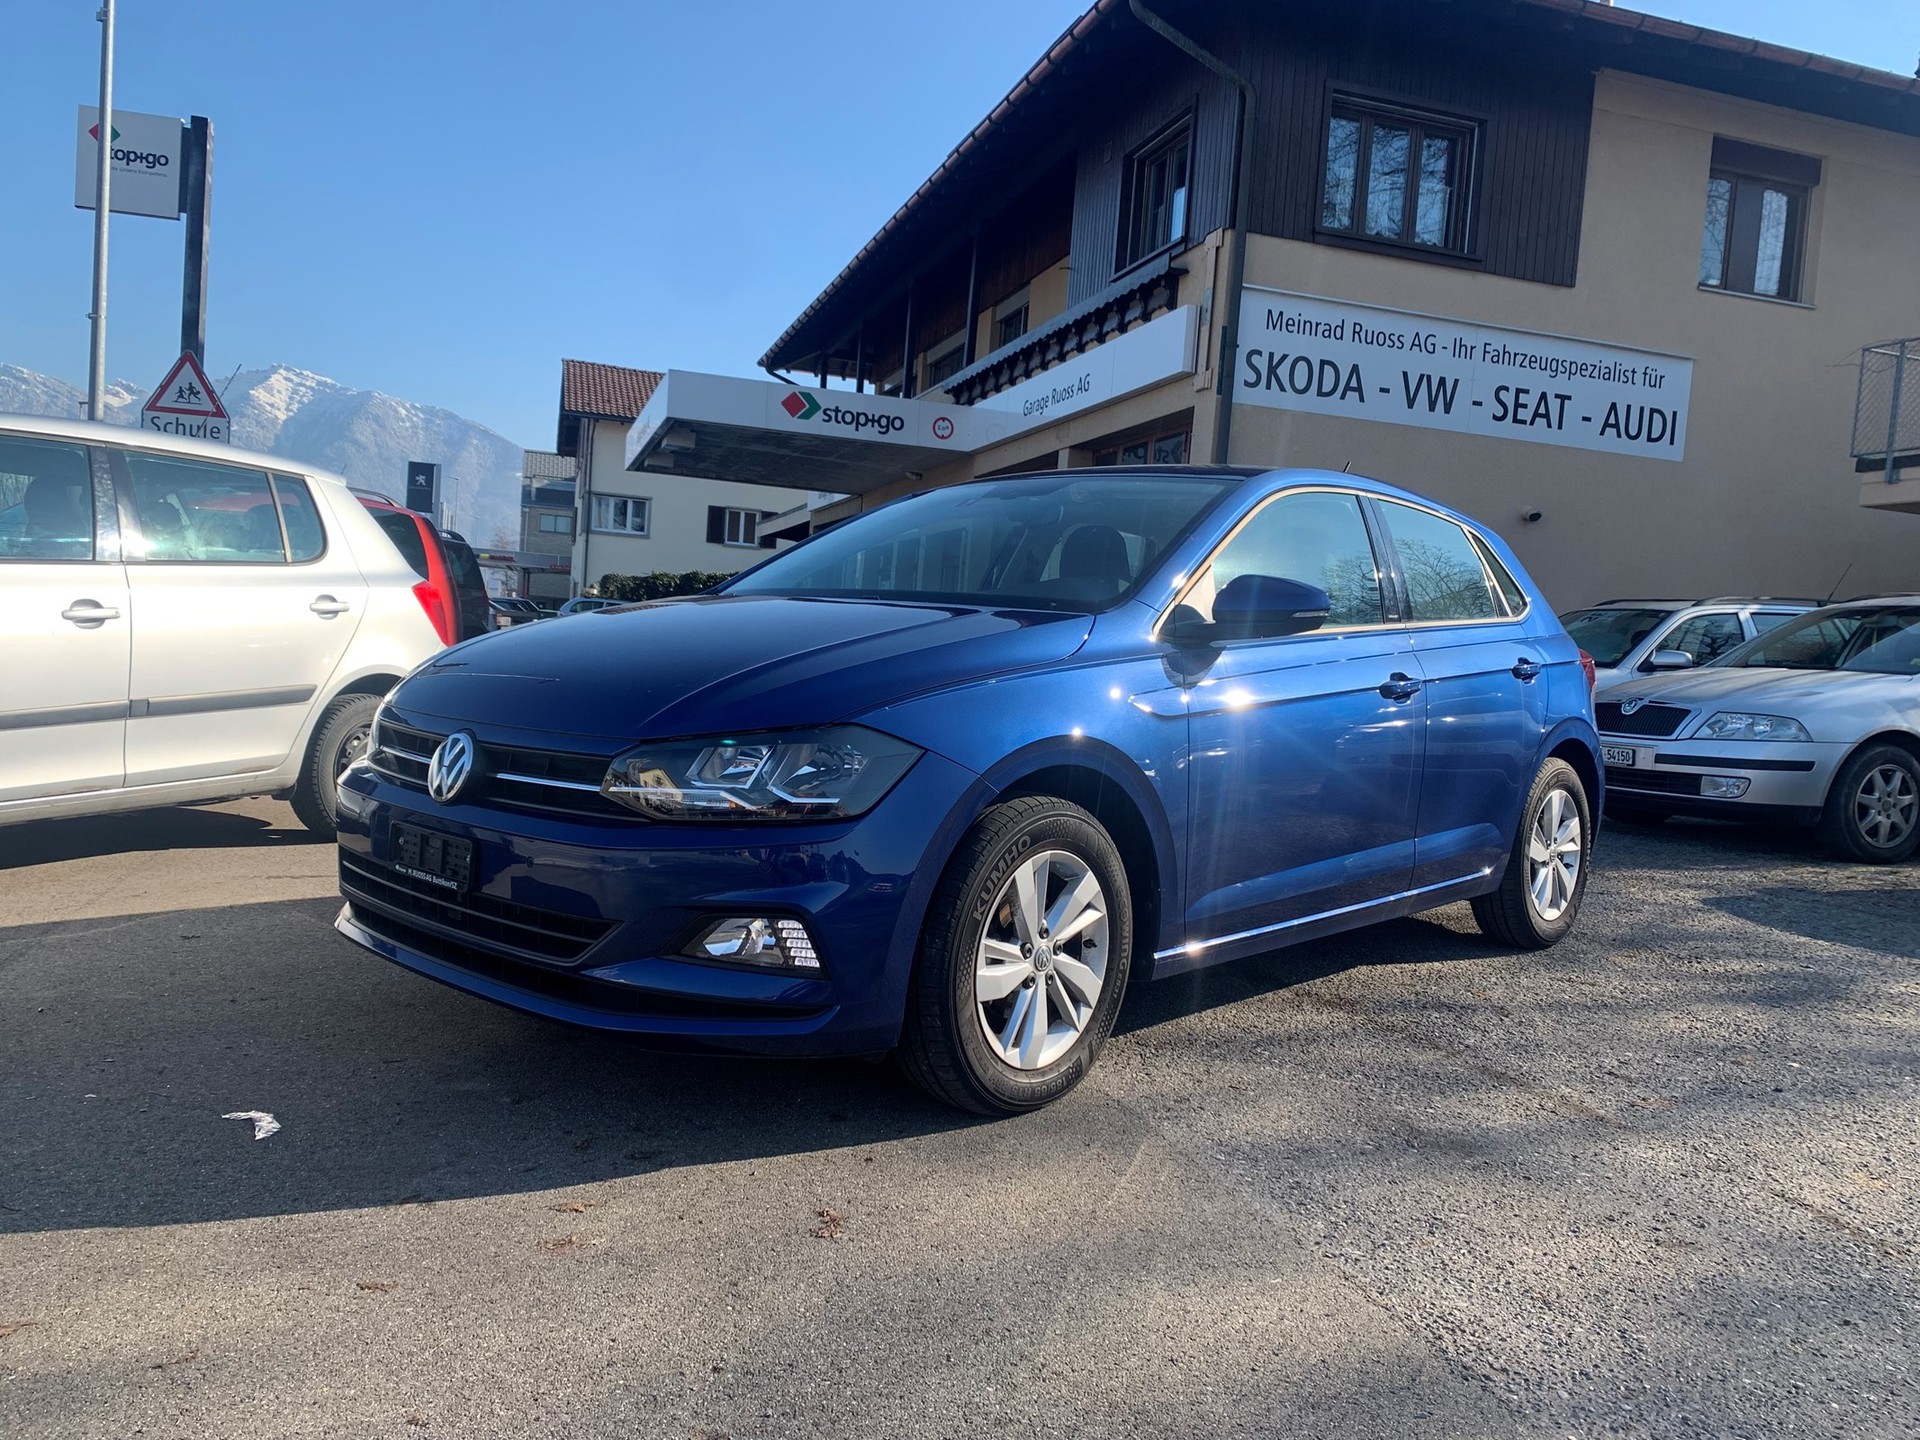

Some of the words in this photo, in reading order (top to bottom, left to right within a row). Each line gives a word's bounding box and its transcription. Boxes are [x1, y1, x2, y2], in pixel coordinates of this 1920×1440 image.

[111, 147, 169, 169] top+go
[1265, 308, 1345, 341] Meinrad
[1351, 321, 1405, 350] Ruoss
[1409, 331, 1437, 355] AG
[1452, 337, 1476, 360] Ihr
[1482, 342, 1637, 386] Fahrzeugspezialist
[1642, 366, 1666, 390] für
[1022, 394, 1050, 417] Garage
[1050, 383, 1075, 406] Ruoss
[1076, 372, 1091, 397] AG
[1243, 348, 1366, 404] SKODA
[1402, 370, 1460, 415] VW
[1491, 384, 1573, 431] SEAT
[1599, 401, 1678, 446] AUDI
[150, 415, 221, 440] Schule
[822, 405, 905, 435] stop+go
[972, 835, 1031, 921] KUMHO
